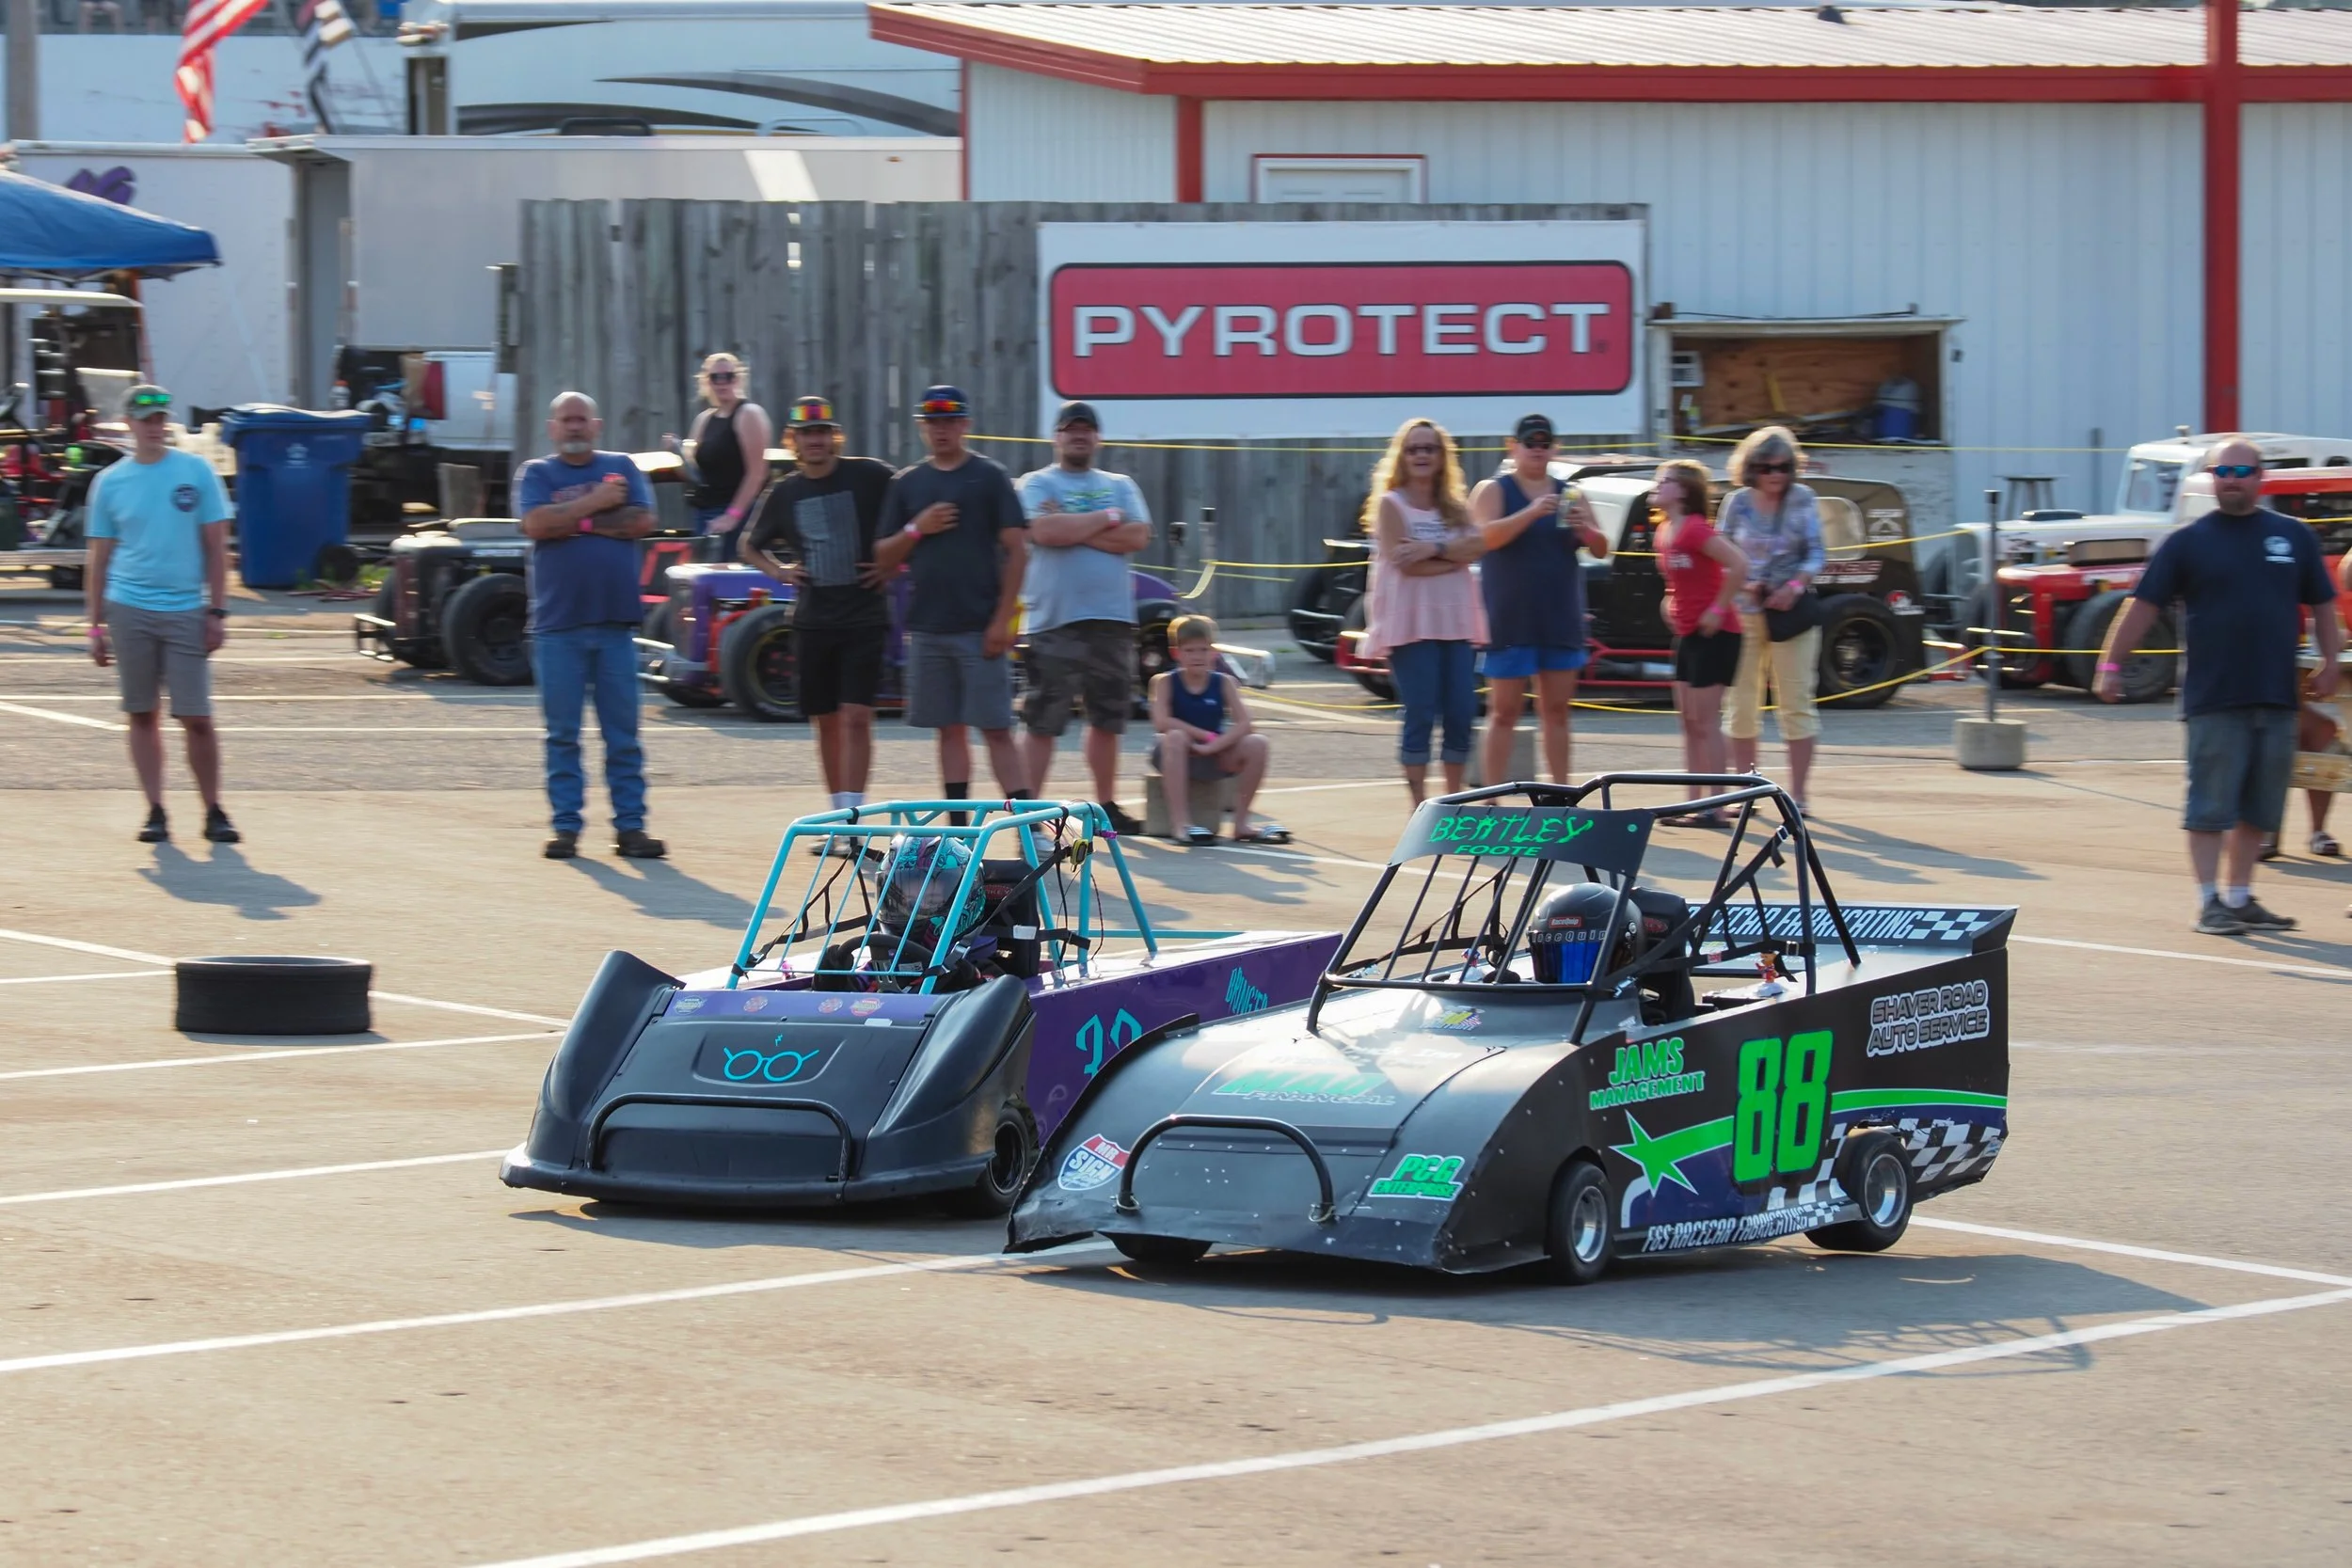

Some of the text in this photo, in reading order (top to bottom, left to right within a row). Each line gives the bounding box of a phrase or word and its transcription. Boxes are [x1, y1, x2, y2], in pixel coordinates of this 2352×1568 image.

[1073, 303, 1611, 357] PYROTECT
[1428, 815, 1595, 844] BENTLEY
[1454, 845, 1543, 857] FOOTE
[1871, 982, 1987, 1024] SHAVER ROAD
[1867, 1008, 1989, 1053] AUTO SERVICE
[1608, 1037, 1684, 1085] JAMS
[1590, 1070, 1706, 1111] MANAGEMENT
[1733, 1029, 1834, 1182] 88
[1068, 1149, 1116, 1180] SIGN
[1094, 1141, 1120, 1162] MR
[1669, 1218, 1737, 1249] RACECAR
[1733, 1207, 1808, 1242] FABRICATING
